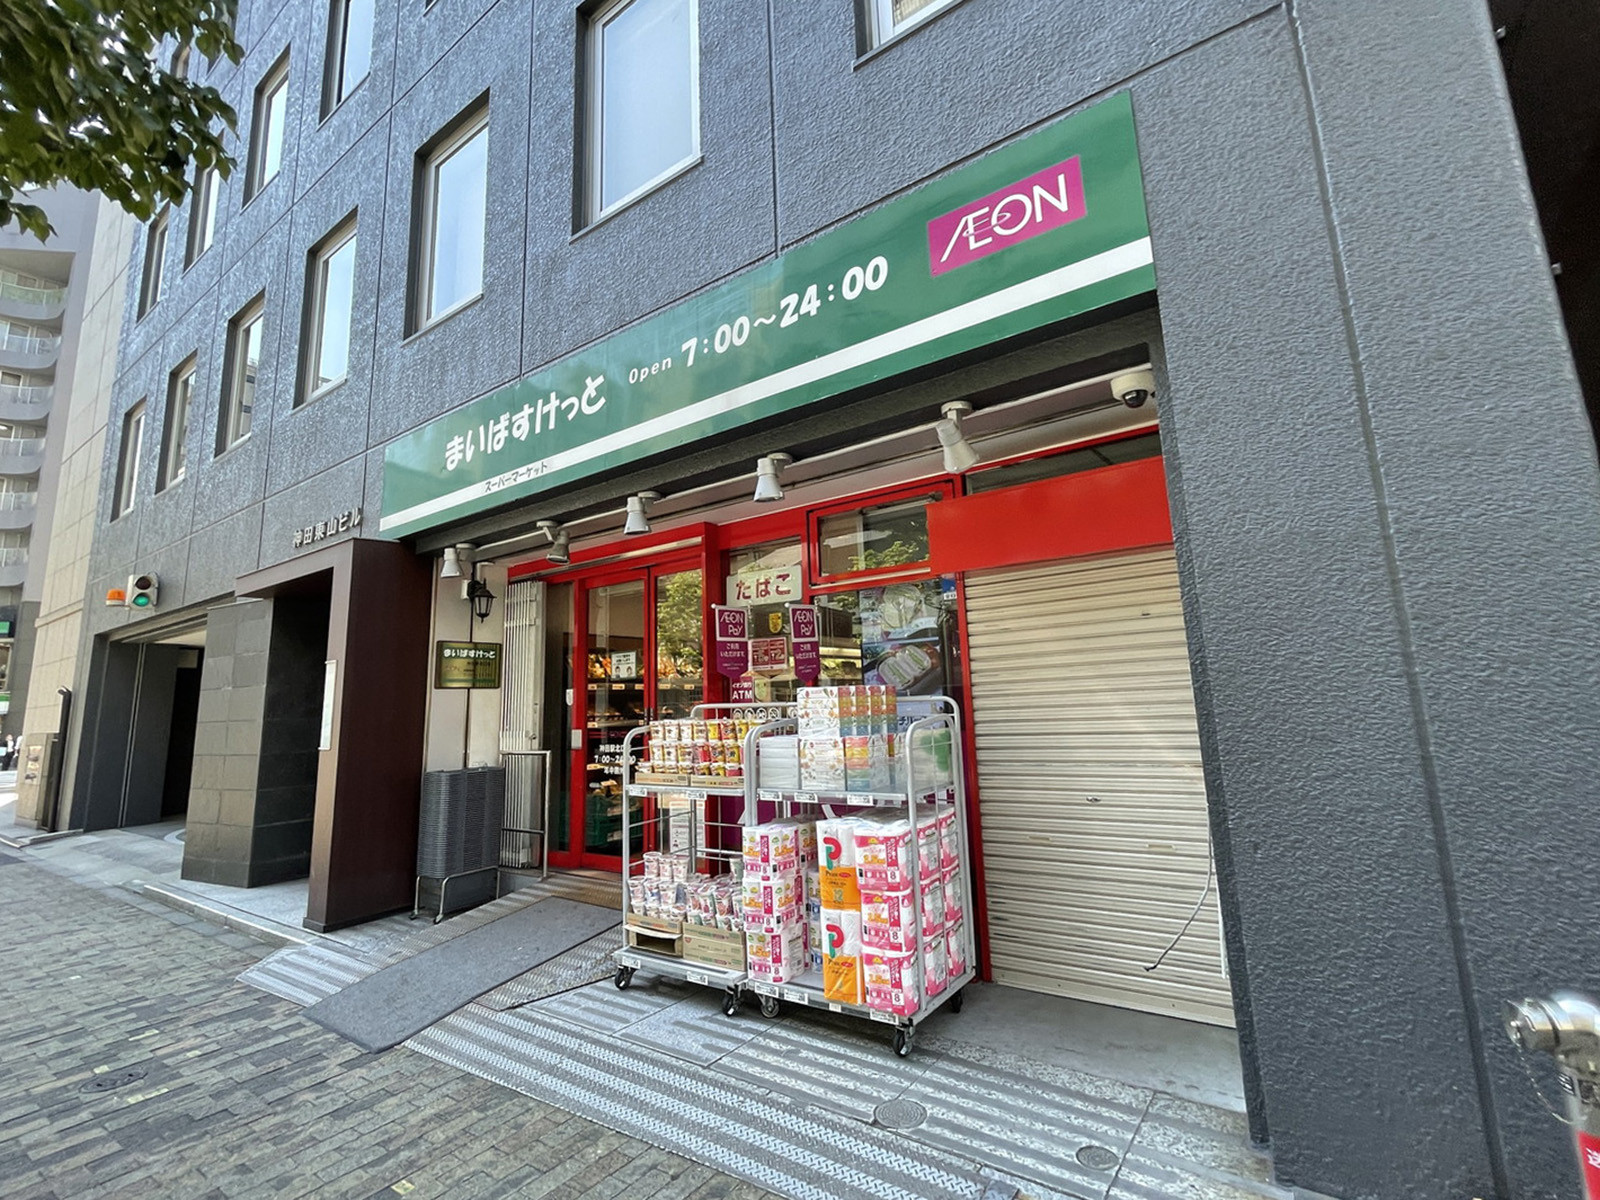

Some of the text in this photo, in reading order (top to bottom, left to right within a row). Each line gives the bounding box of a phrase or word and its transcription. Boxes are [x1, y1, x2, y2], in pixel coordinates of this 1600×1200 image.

[628, 357, 672, 384] Open
[445, 374, 606, 471] まいばすけっと
[484, 462, 548, 493] スーパーマーケット
[293, 507, 362, 548] 神田東山ビル
[735, 573, 791, 600] たばこ
[443, 649, 496, 659] まいばすけっと
[732, 690, 752, 700] ATM
[890, 871, 897, 880] 8
[892, 931, 899, 940] 8
[773, 967, 780, 976] 8
[894, 993, 901, 1003] 8
